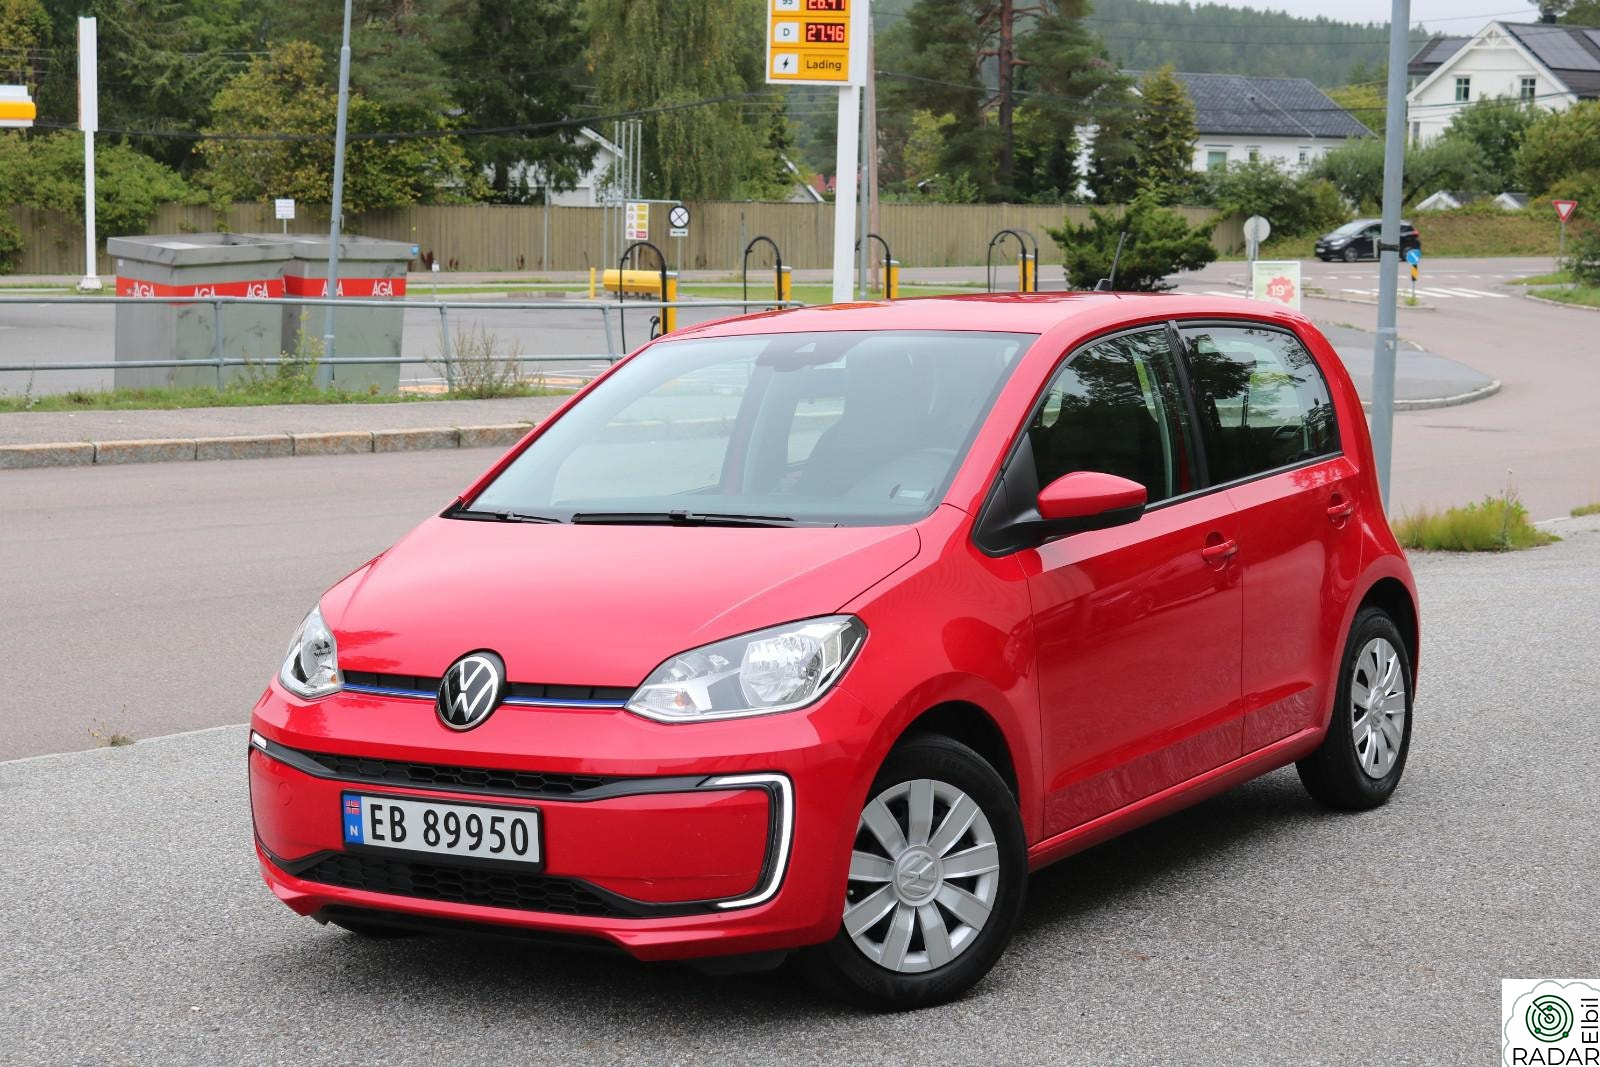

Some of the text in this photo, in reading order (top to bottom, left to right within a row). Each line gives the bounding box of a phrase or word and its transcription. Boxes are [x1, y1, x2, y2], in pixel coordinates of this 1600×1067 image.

[783, 25, 844, 41] D 27.46
[806, 60, 842, 71] Lading
[134, 281, 155, 298] AGA
[246, 282, 269, 298] AGA
[322, 280, 343, 296] AA
[372, 280, 393, 296] AGA
[350, 825, 358, 836] N
[370, 803, 529, 856] EB 89950
